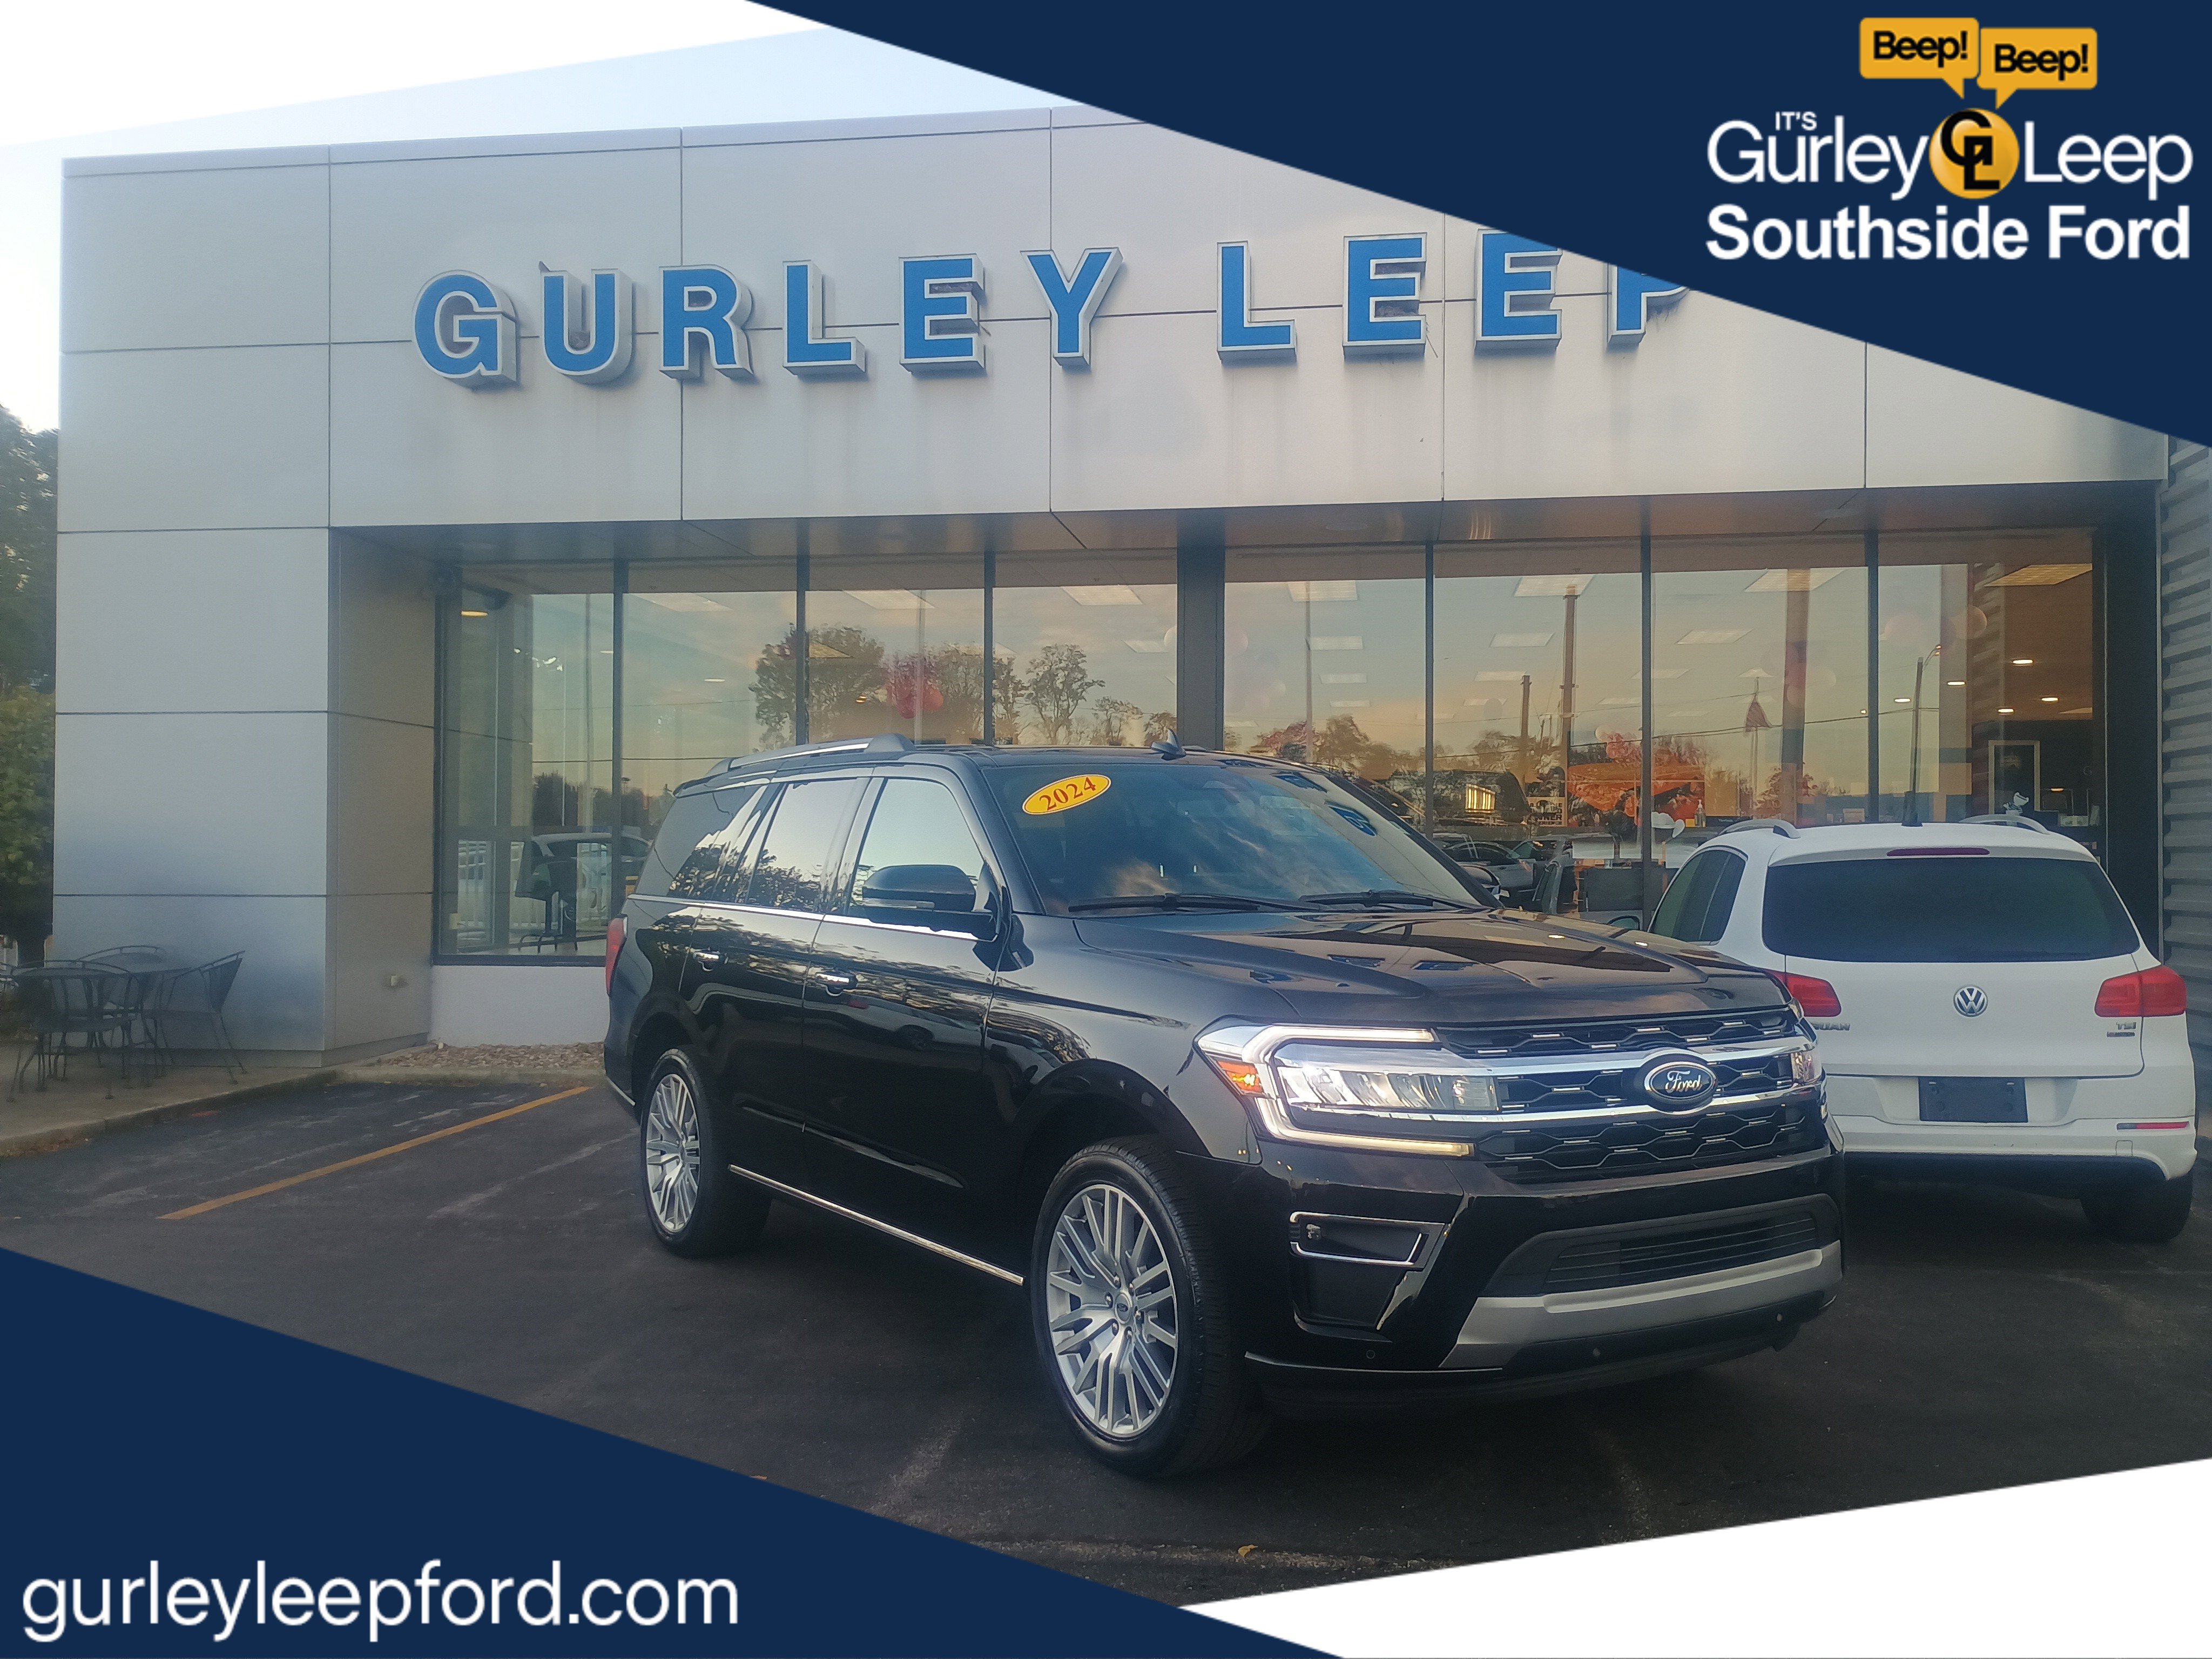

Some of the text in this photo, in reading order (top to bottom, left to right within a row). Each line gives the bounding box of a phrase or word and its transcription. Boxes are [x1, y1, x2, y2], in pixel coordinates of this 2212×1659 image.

[413, 247, 1122, 385] GURLEY
[1038, 777, 1096, 811] 2024
[1665, 1070, 1702, 1094] Ford
